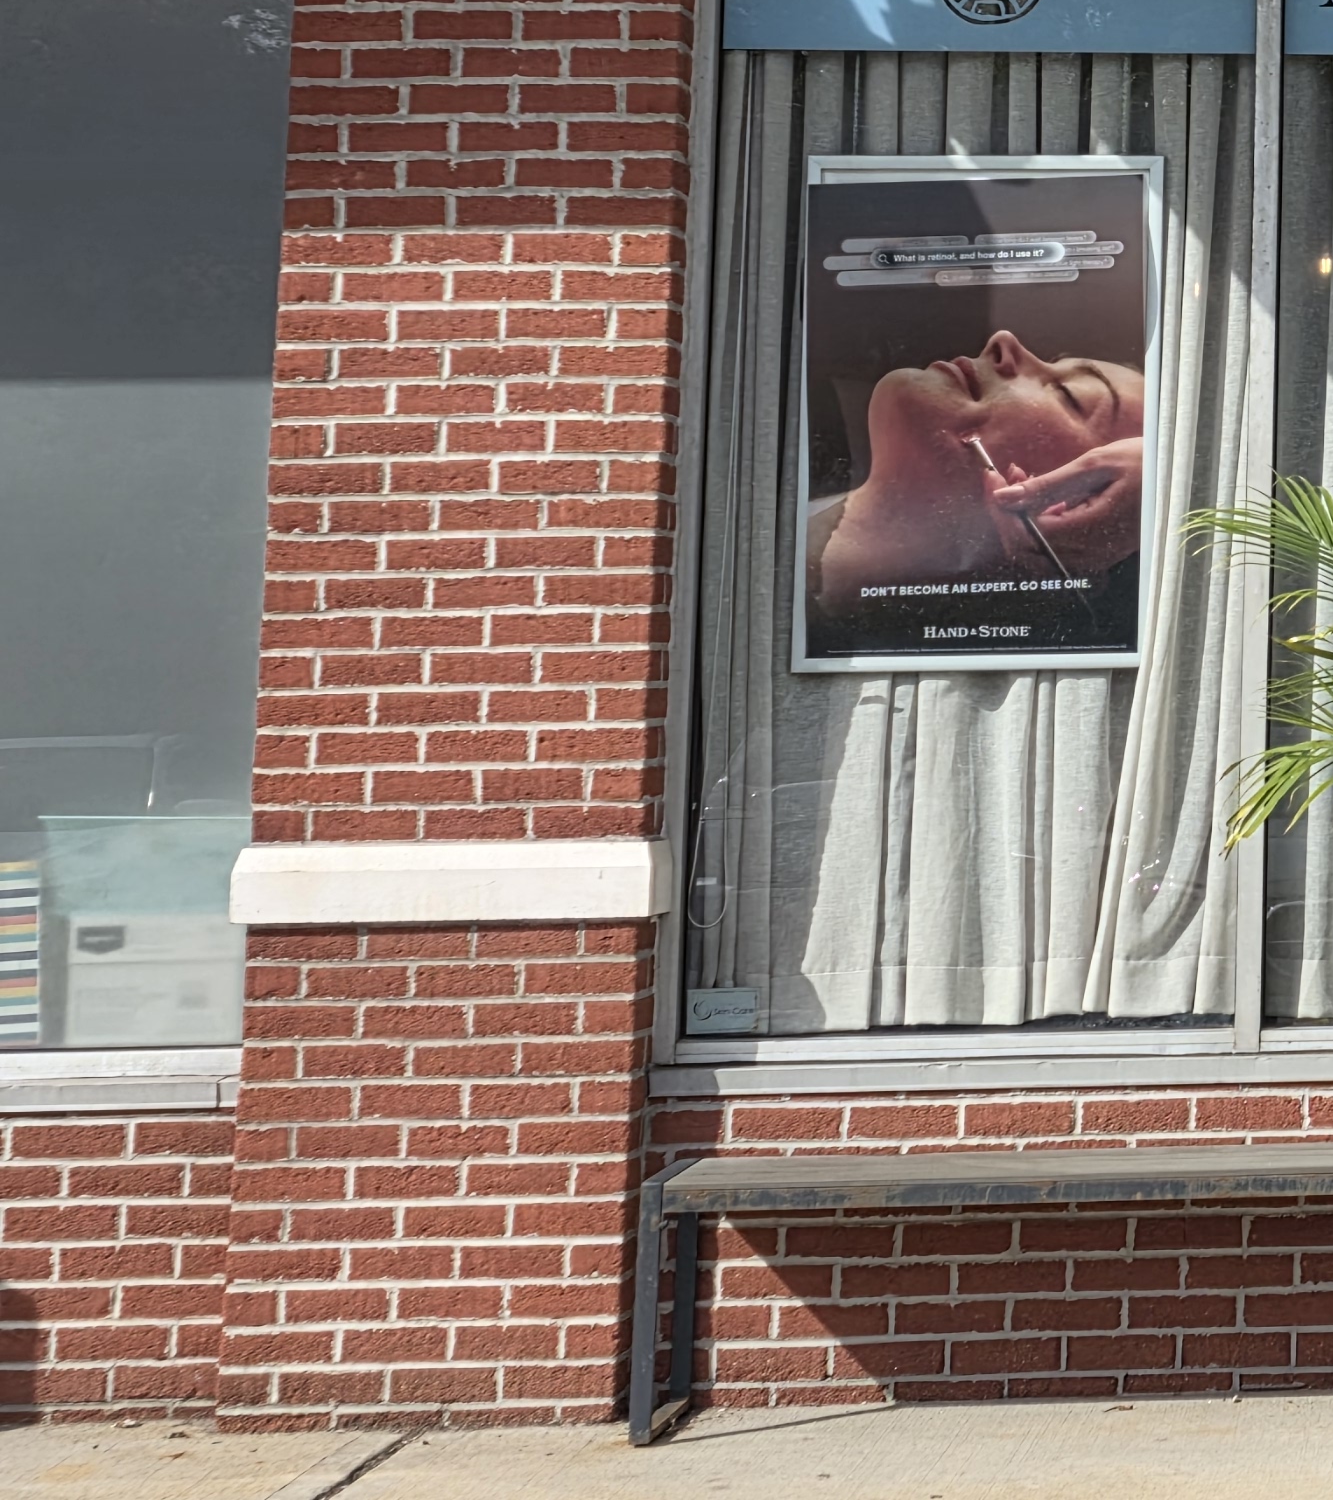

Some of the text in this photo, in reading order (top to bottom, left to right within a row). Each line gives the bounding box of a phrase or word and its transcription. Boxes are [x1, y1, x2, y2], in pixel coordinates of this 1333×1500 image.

[893, 254, 916, 263] What
[918, 254, 926, 262] is
[959, 252, 976, 260] and
[977, 251, 996, 259] how
[997, 250, 1009, 259] do
[1015, 250, 1031, 258] use
[1032, 249, 1045, 258] it?
[860, 578, 1092, 598] DON'T BECOME AN EXPERT. GO SEE ONE.
[923, 626, 968, 638] HAND
